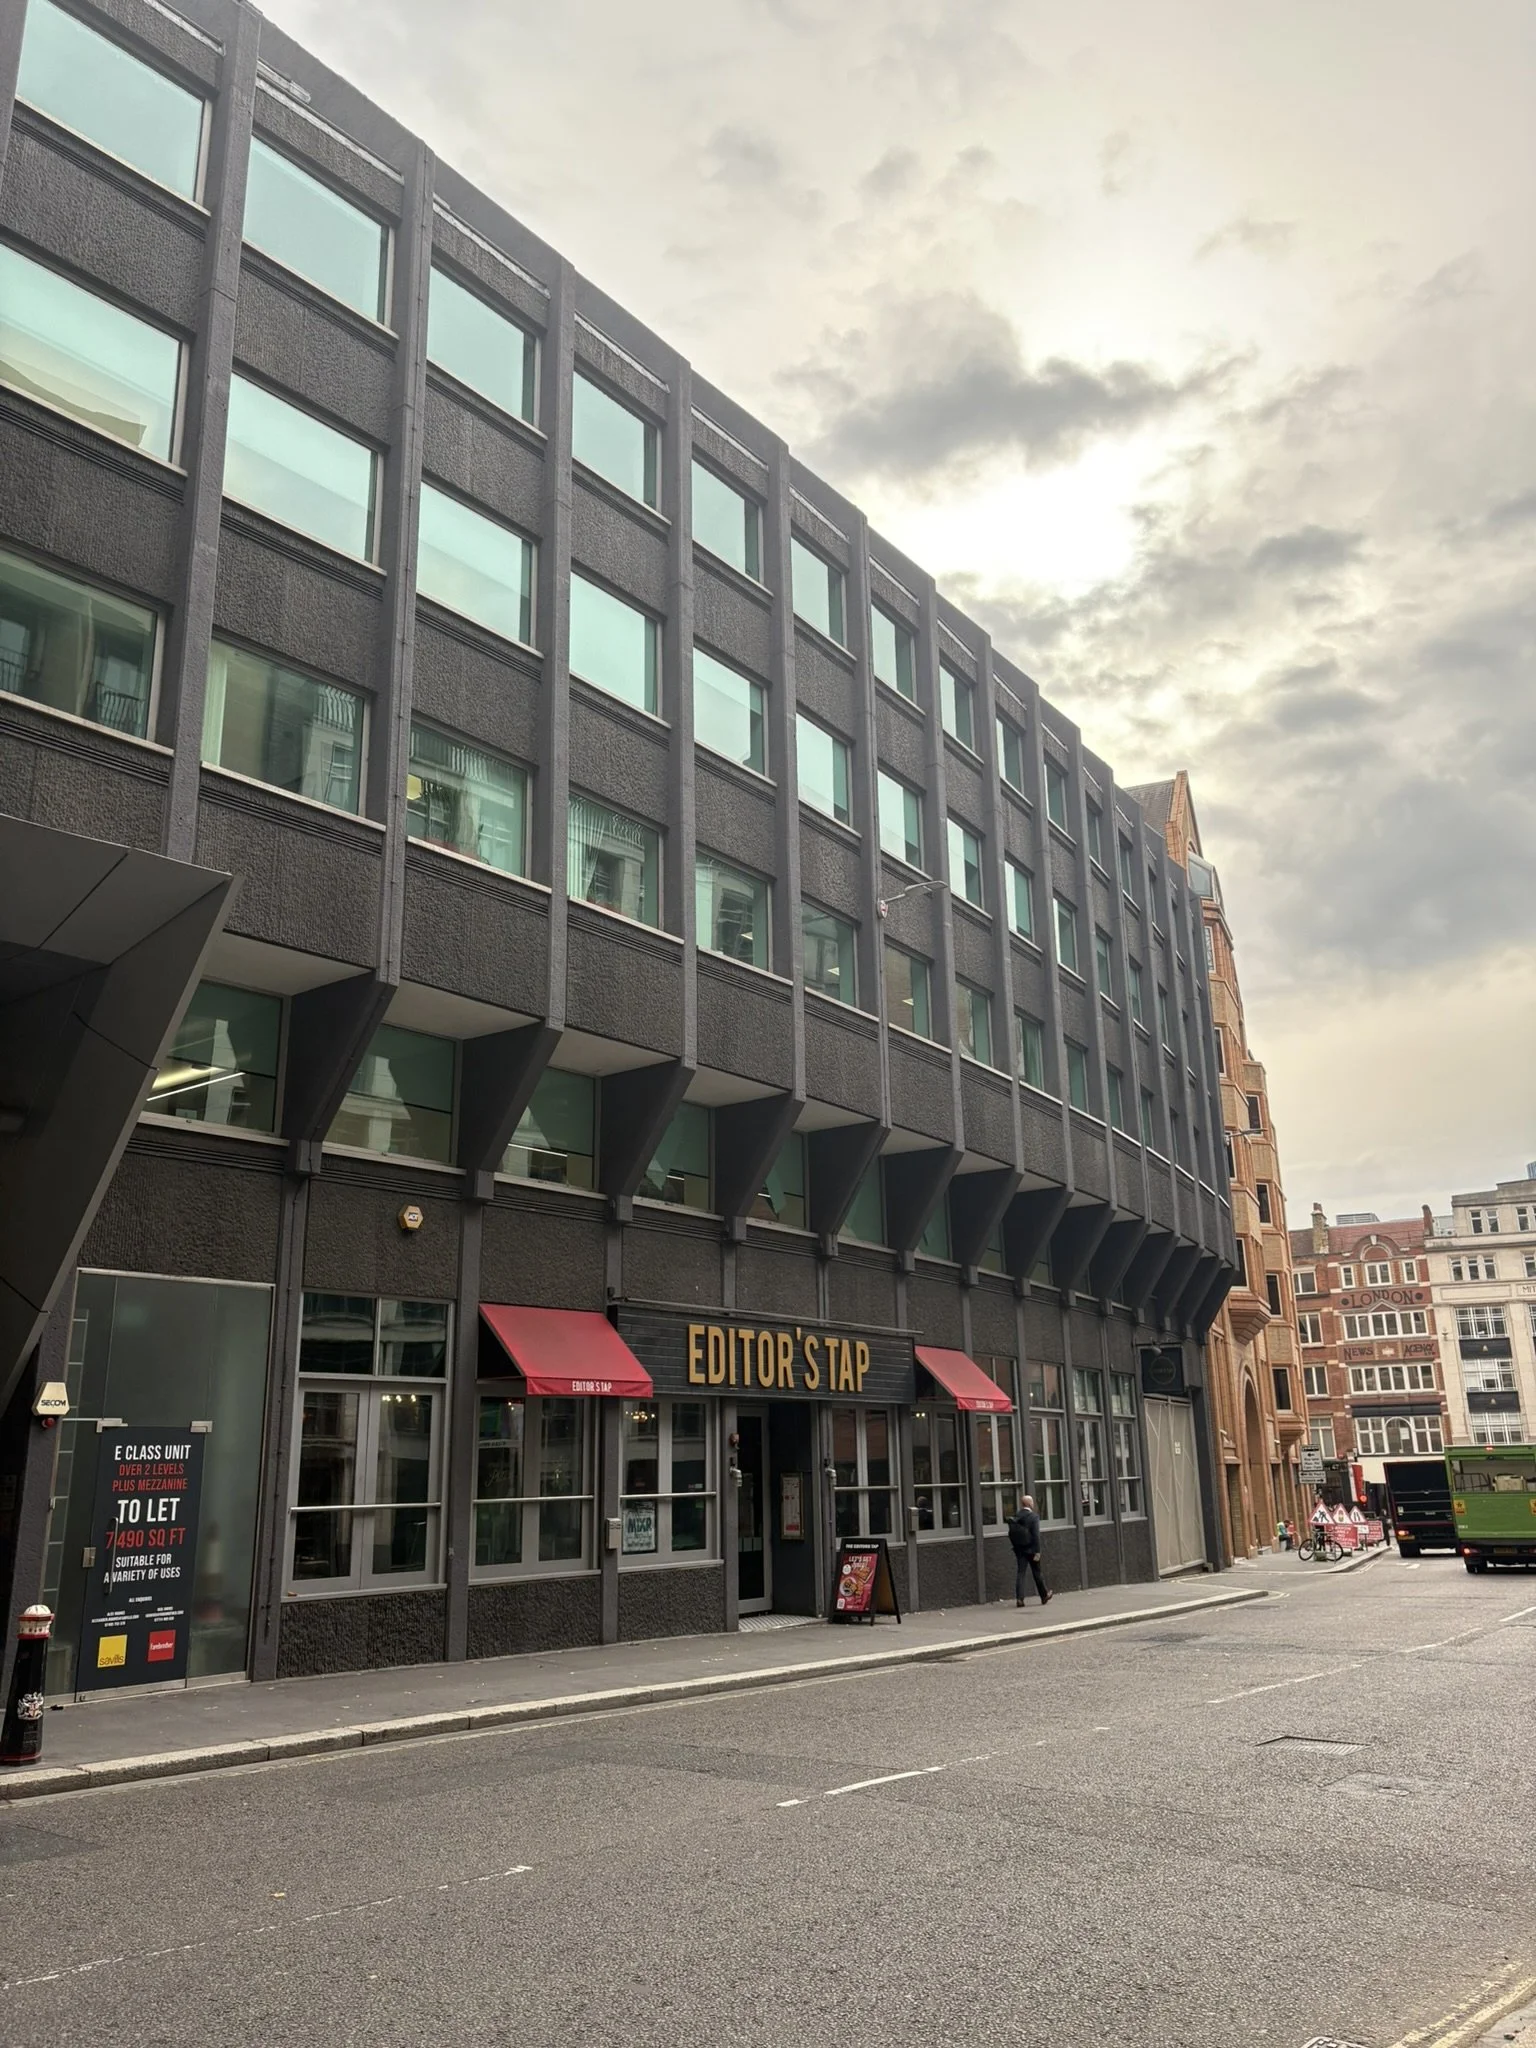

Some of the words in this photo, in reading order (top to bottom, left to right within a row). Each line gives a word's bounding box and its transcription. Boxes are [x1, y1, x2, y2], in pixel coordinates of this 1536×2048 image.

[1350, 1290, 1415, 1308] LONDON
[688, 1323, 820, 1390] EDITOR'S
[824, 1337, 870, 1392] TAP
[1343, 1347, 1374, 1360] NEWS
[572, 1380, 600, 1392] EDITOR'S
[601, 1381, 612, 1392] TAP
[115, 1446, 122, 1460] E
[126, 1445, 162, 1460] CLASS
[165, 1445, 191, 1459] UNIT
[119, 1464, 142, 1476] OVER
[145, 1464, 151, 1475] 2
[153, 1463, 185, 1475] LEVELS
[112, 1480, 135, 1492] PLUS
[138, 1478, 188, 1491] MEZZANINE
[117, 1499, 140, 1523] TO
[147, 1498, 180, 1522] LET
[148, 1528, 165, 1547] SQ
[169, 1527, 186, 1545] FT
[115, 1555, 155, 1568] SUITABLE
[156, 1553, 172, 1565] FOR
[103, 1572, 110, 1583] A
[112, 1569, 146, 1583] VARIETY
[148, 1569, 158, 1580] OF
[160, 1567, 181, 1579] USES
[99, 1654, 124, 1665] savills
